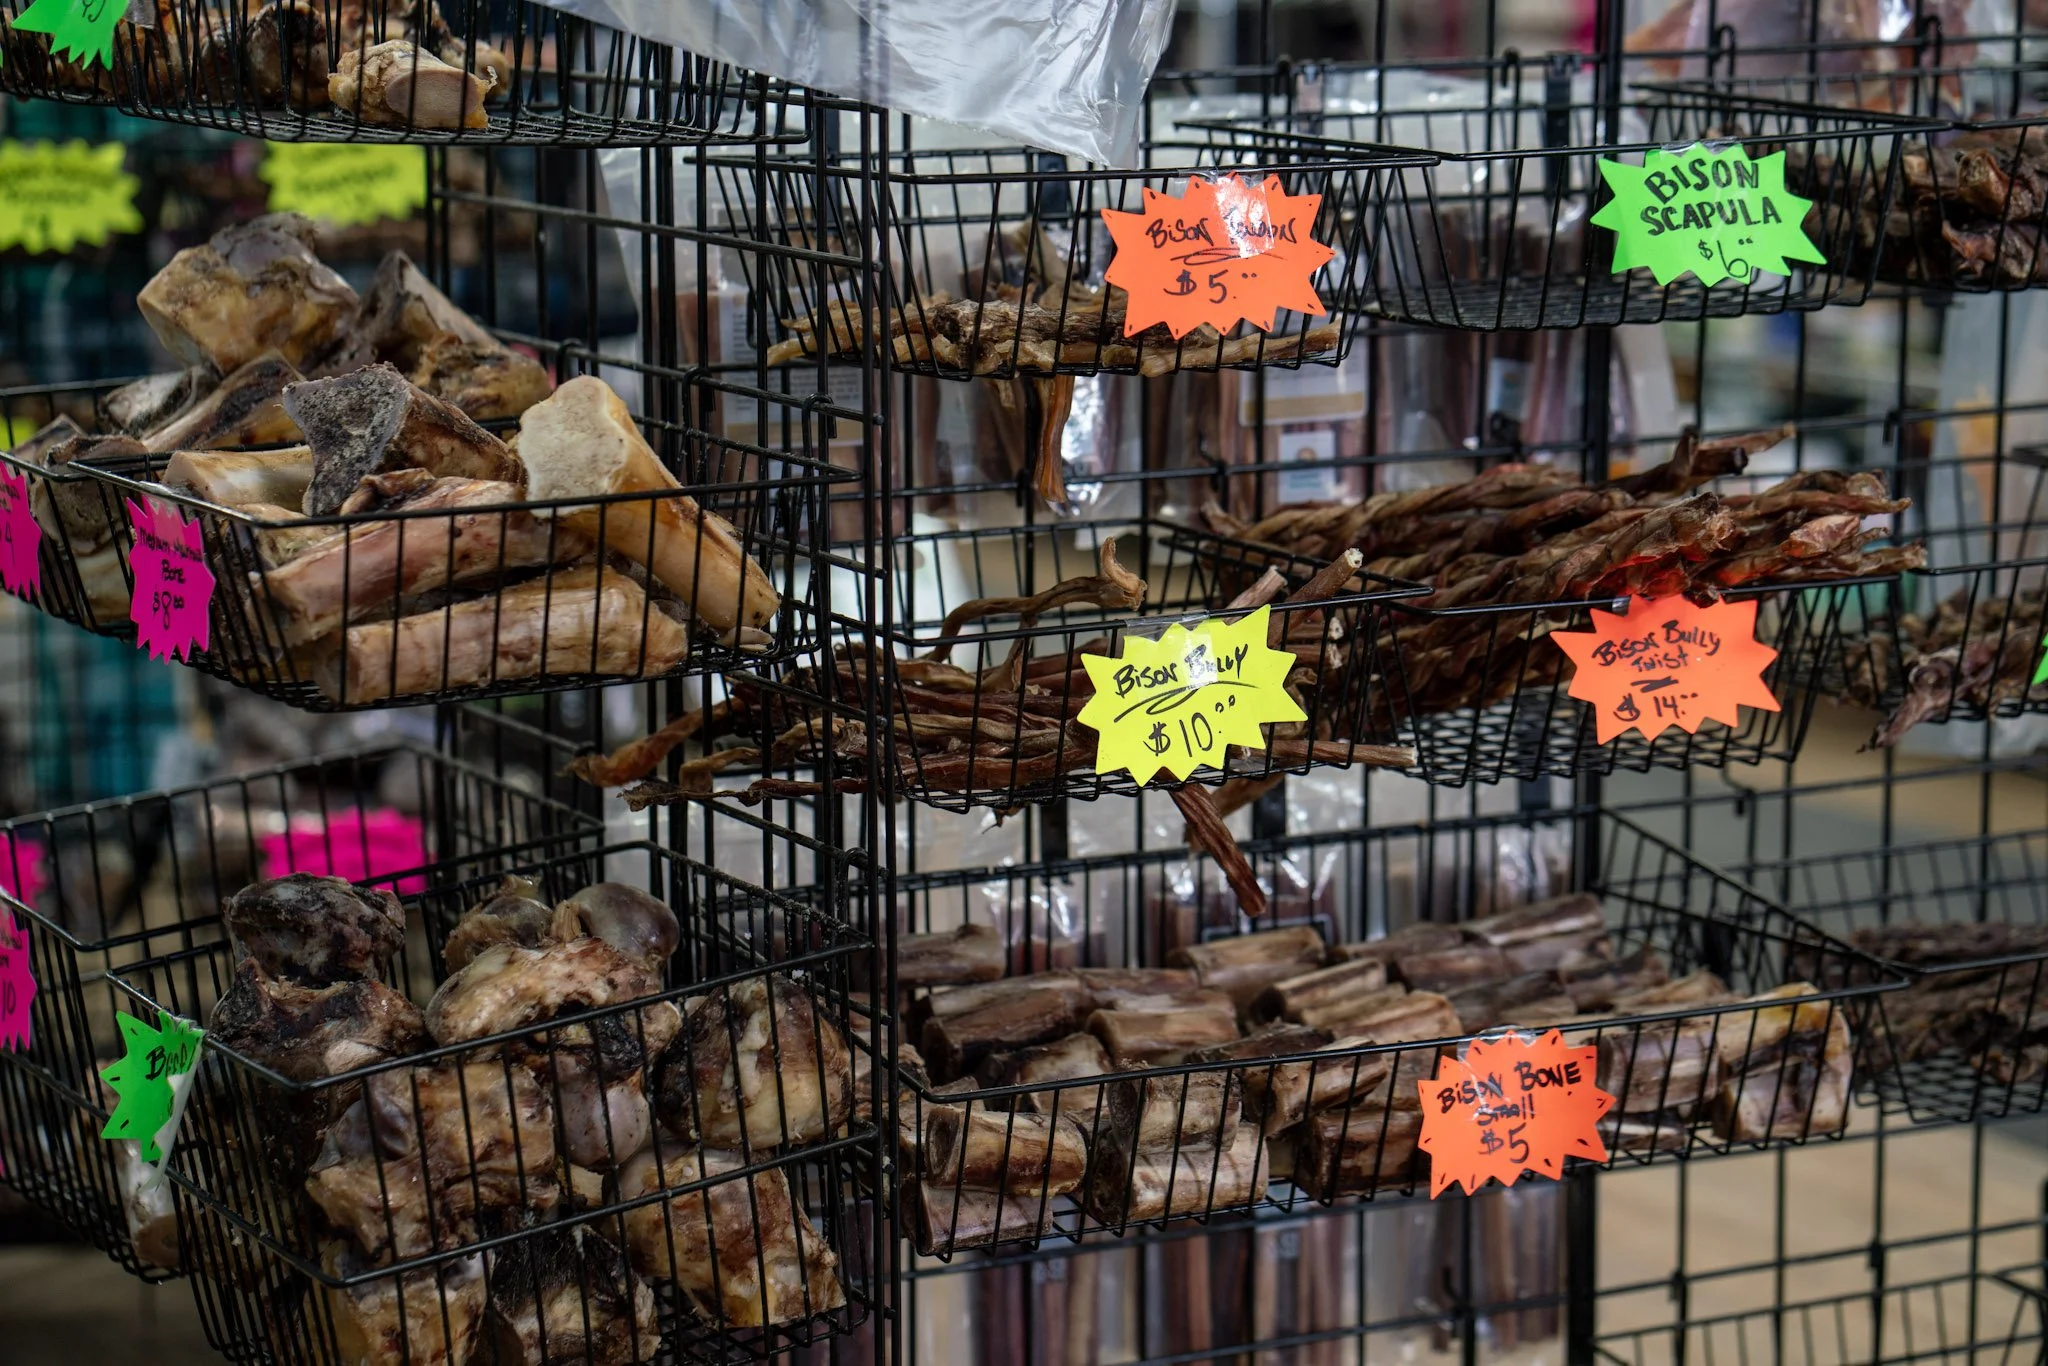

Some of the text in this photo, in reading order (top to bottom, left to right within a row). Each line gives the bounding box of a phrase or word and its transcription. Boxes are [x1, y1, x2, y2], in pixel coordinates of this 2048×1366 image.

[1644, 158, 1759, 205] BISON
[1640, 196, 1782, 236] SCAPULA
[1514, 1060, 1582, 1092] BONE
[1478, 1122, 1530, 1163] $5
